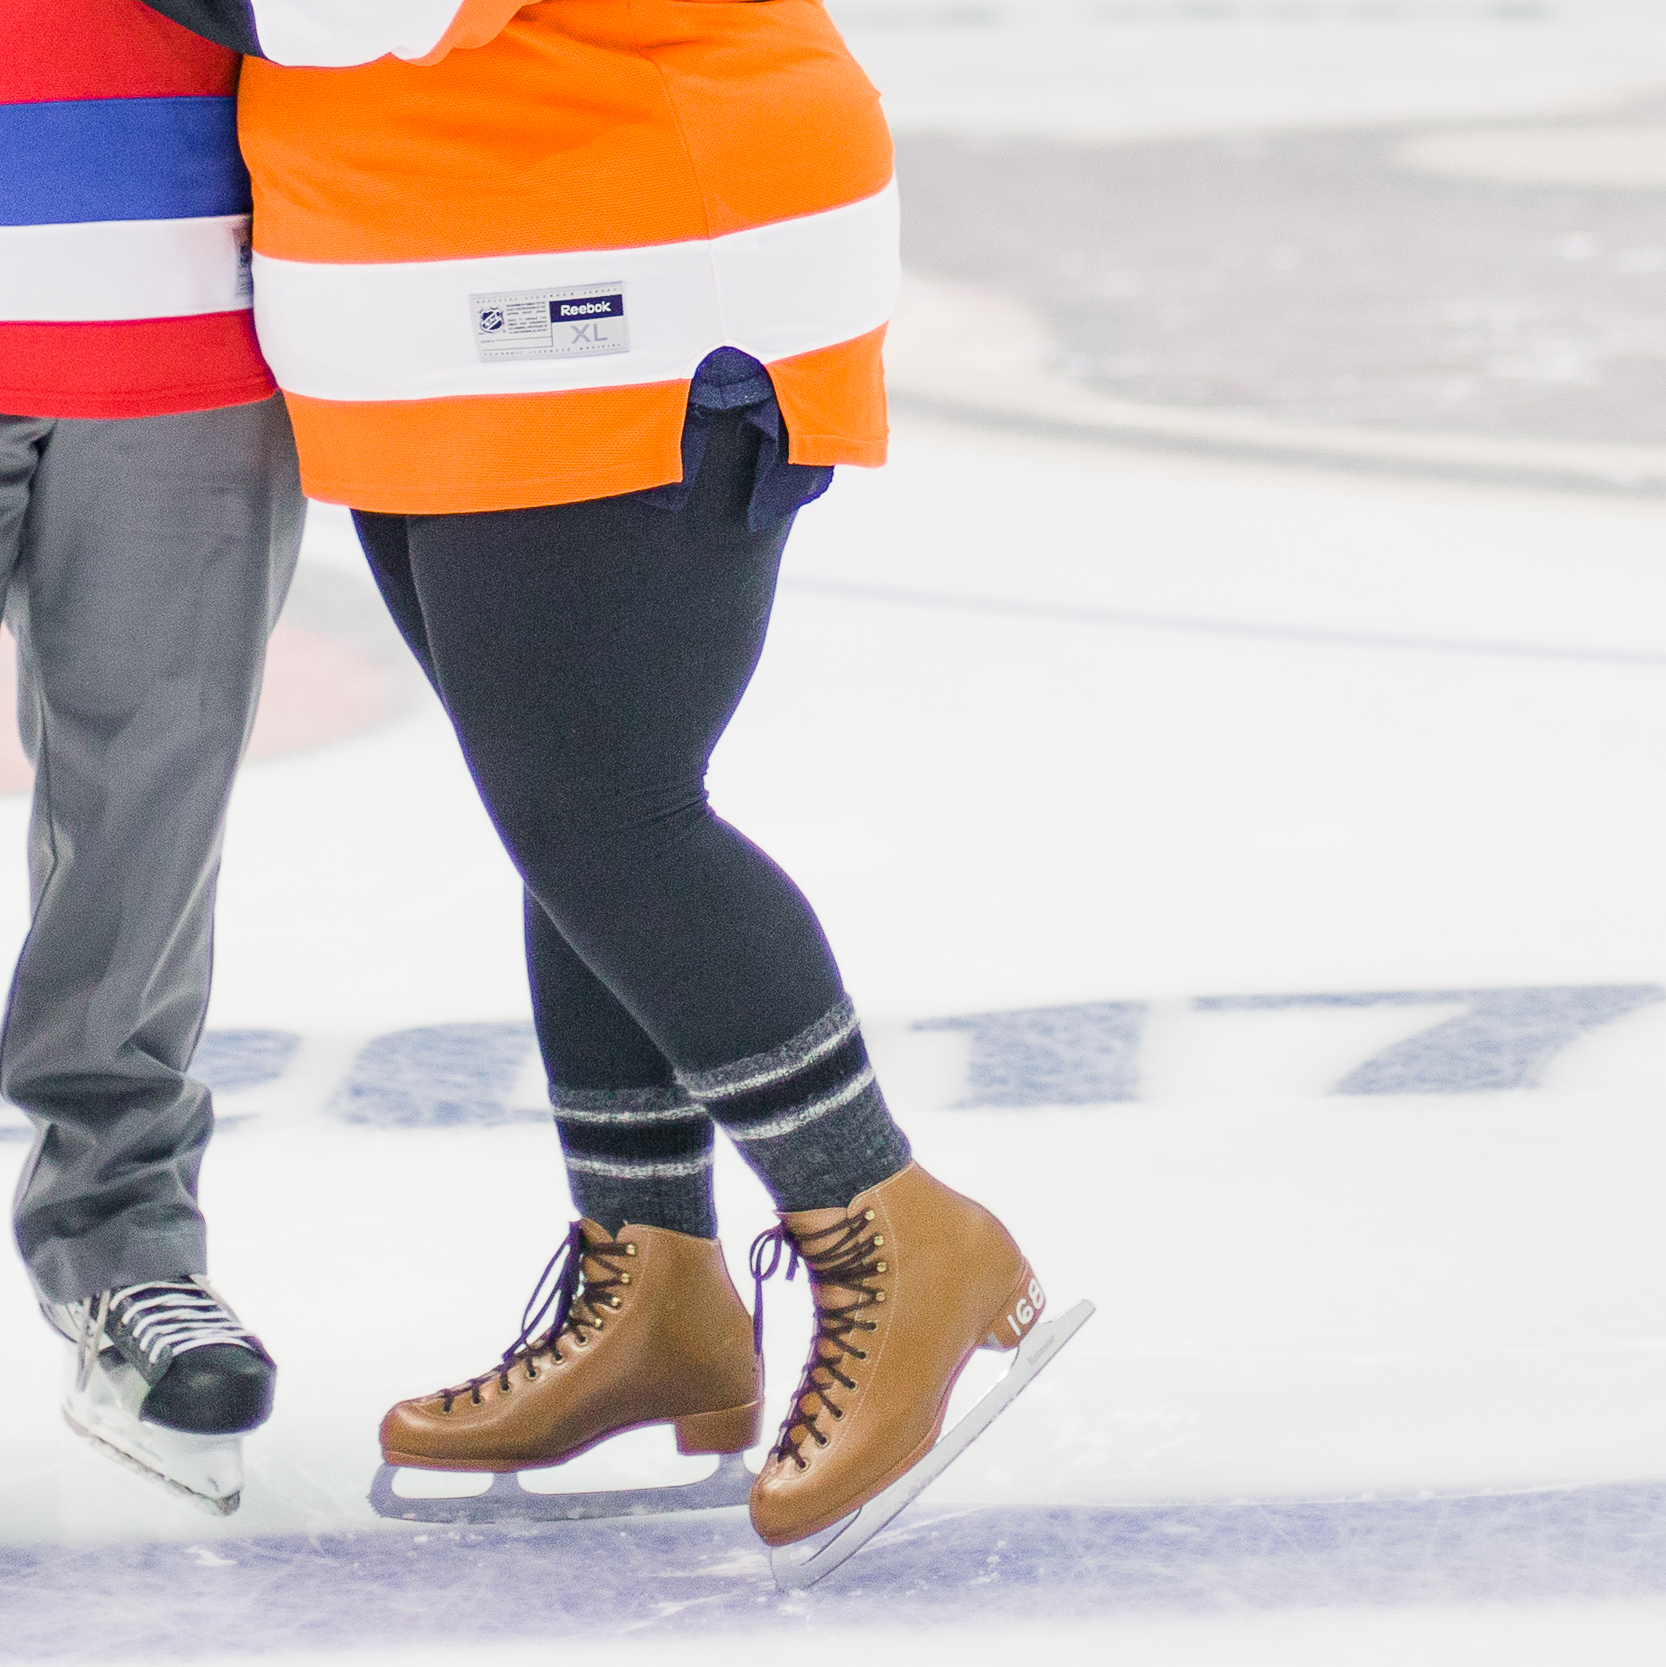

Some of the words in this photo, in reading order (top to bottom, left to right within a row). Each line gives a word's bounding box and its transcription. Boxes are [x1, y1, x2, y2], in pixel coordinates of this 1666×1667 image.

[560, 301, 612, 317] Reebok
[571, 323, 608, 344] XL
[1007, 1277, 1045, 1337] 168
